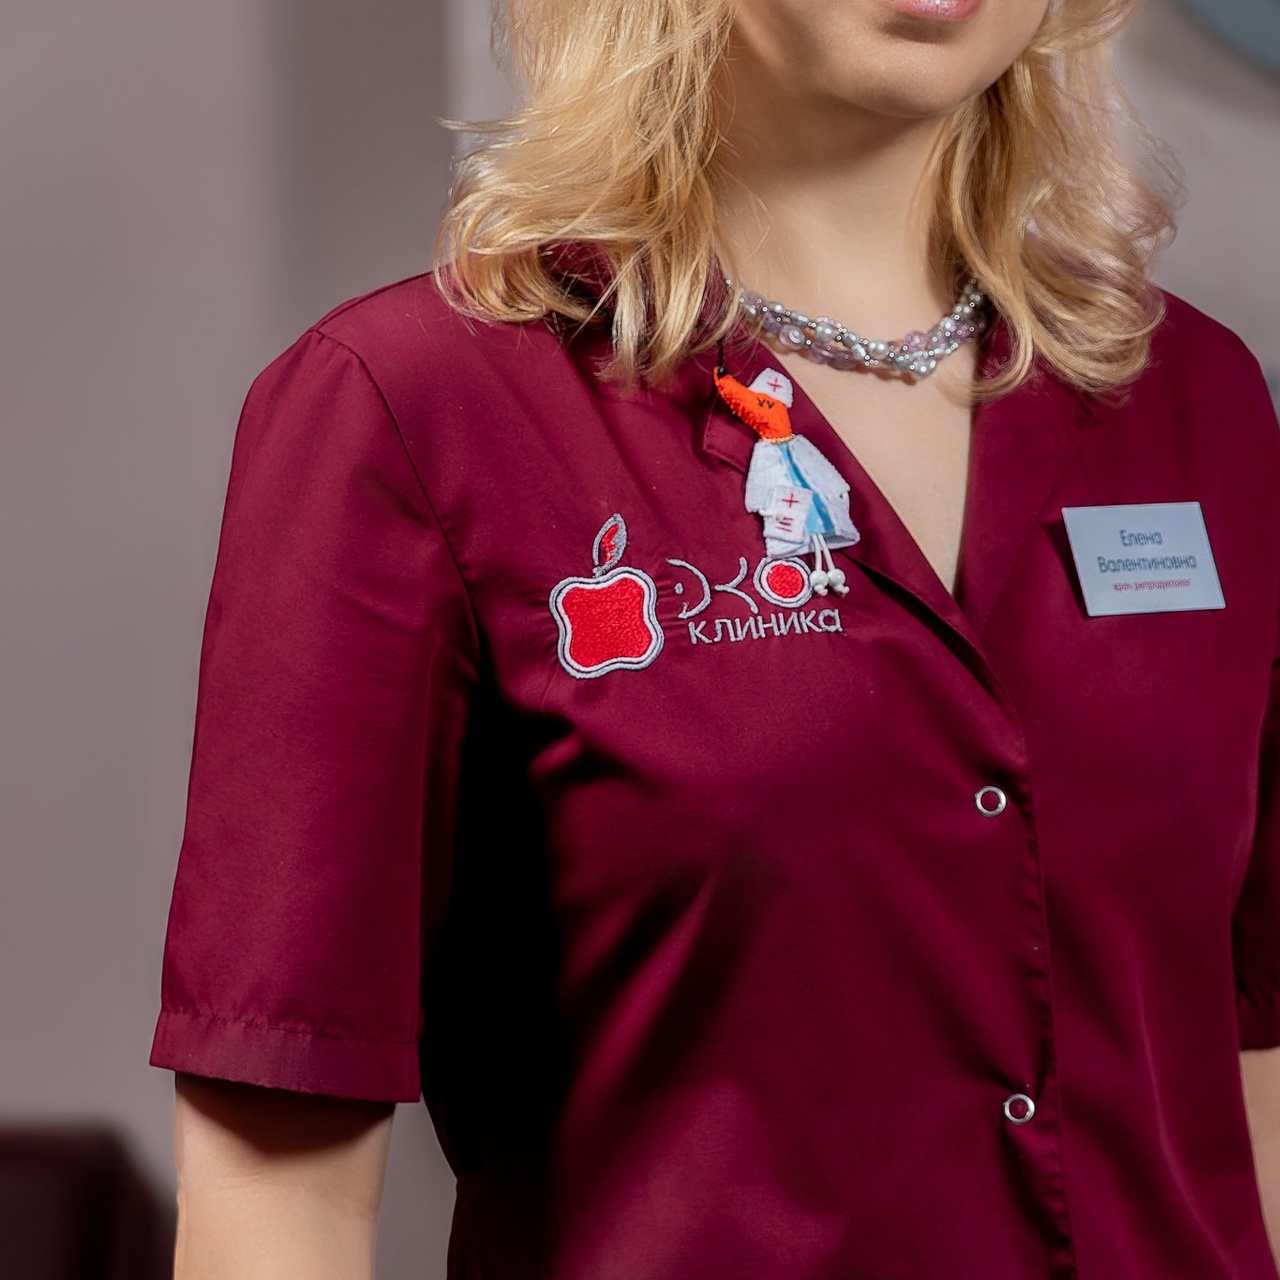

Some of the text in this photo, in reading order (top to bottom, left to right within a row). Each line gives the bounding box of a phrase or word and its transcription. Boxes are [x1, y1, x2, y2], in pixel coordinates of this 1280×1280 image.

[1119, 529, 1163, 547] Елена
[1096, 554, 1198, 574] Валентиновна
[688, 608, 844, 645] клиника
